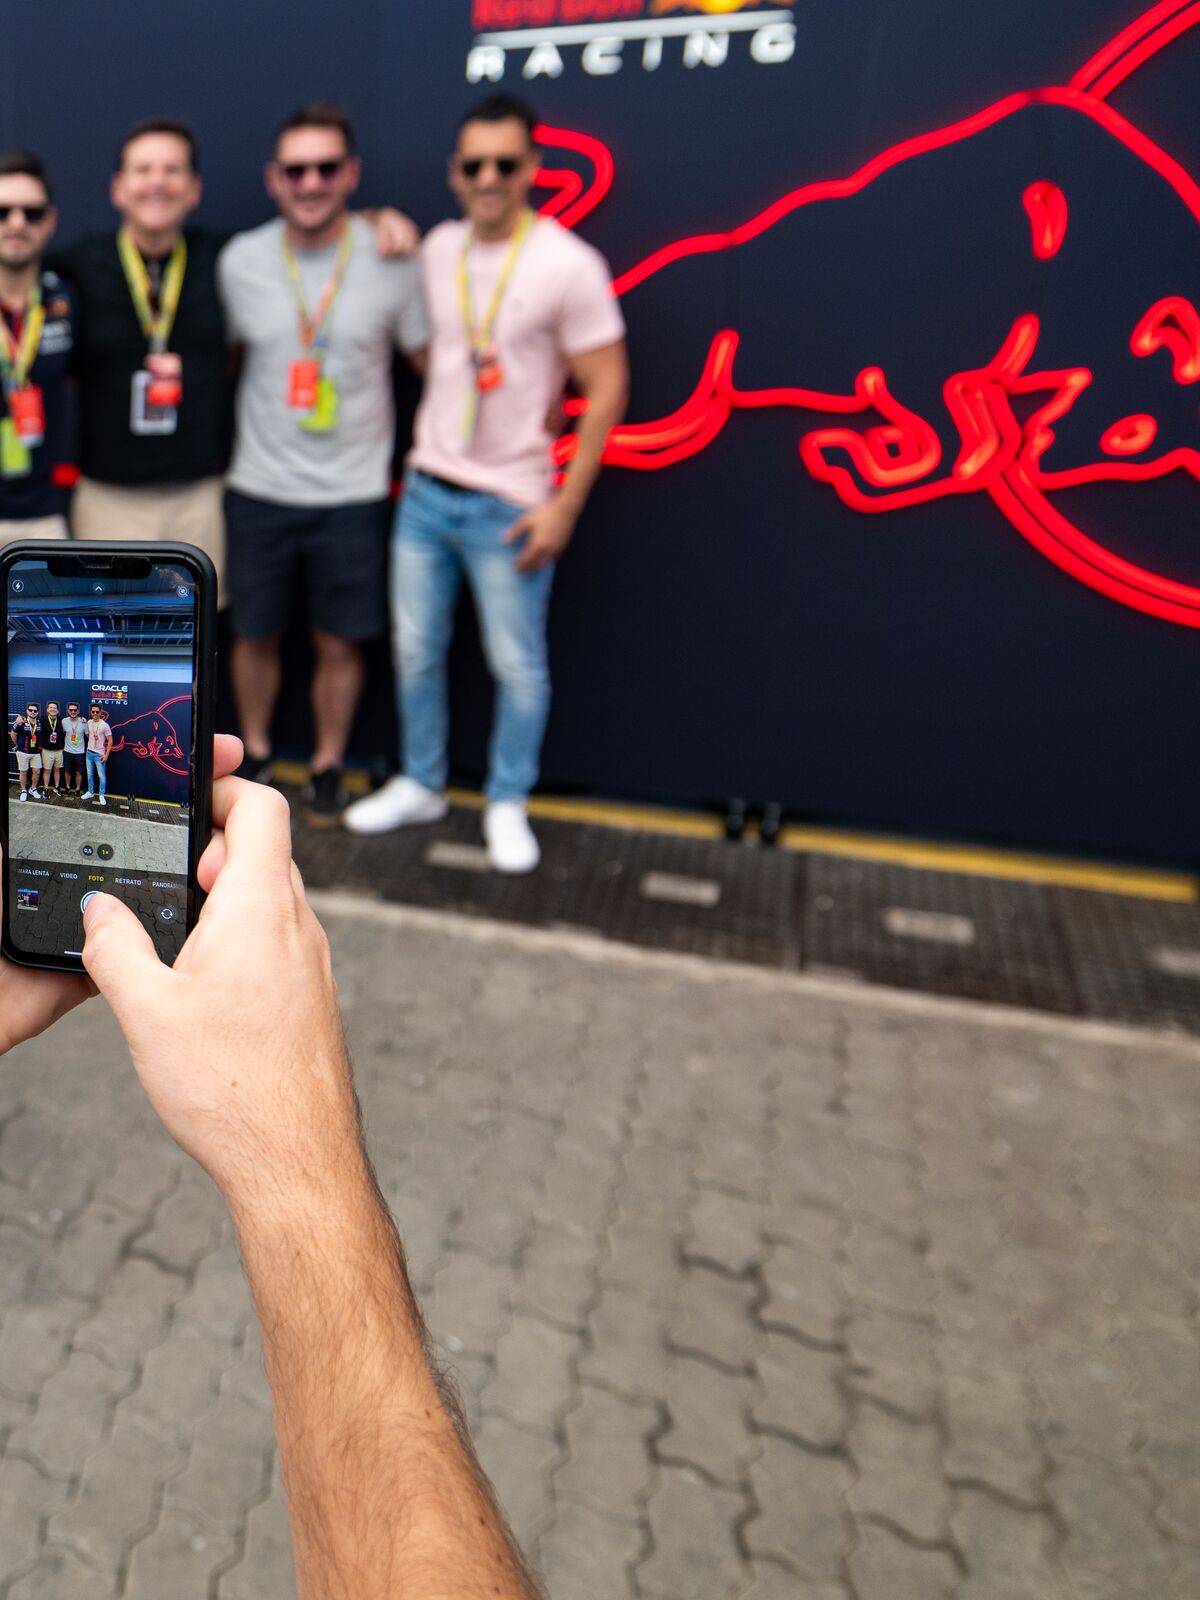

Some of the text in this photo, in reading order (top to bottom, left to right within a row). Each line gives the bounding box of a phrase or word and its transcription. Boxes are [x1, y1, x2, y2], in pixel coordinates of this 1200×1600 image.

[466, 22, 797, 84] RACING
[91, 684, 129, 692] ORACLE
[32, 869, 50, 877] LENTA
[60, 872, 78, 880] VIDEO
[115, 877, 142, 886] RETRATO
